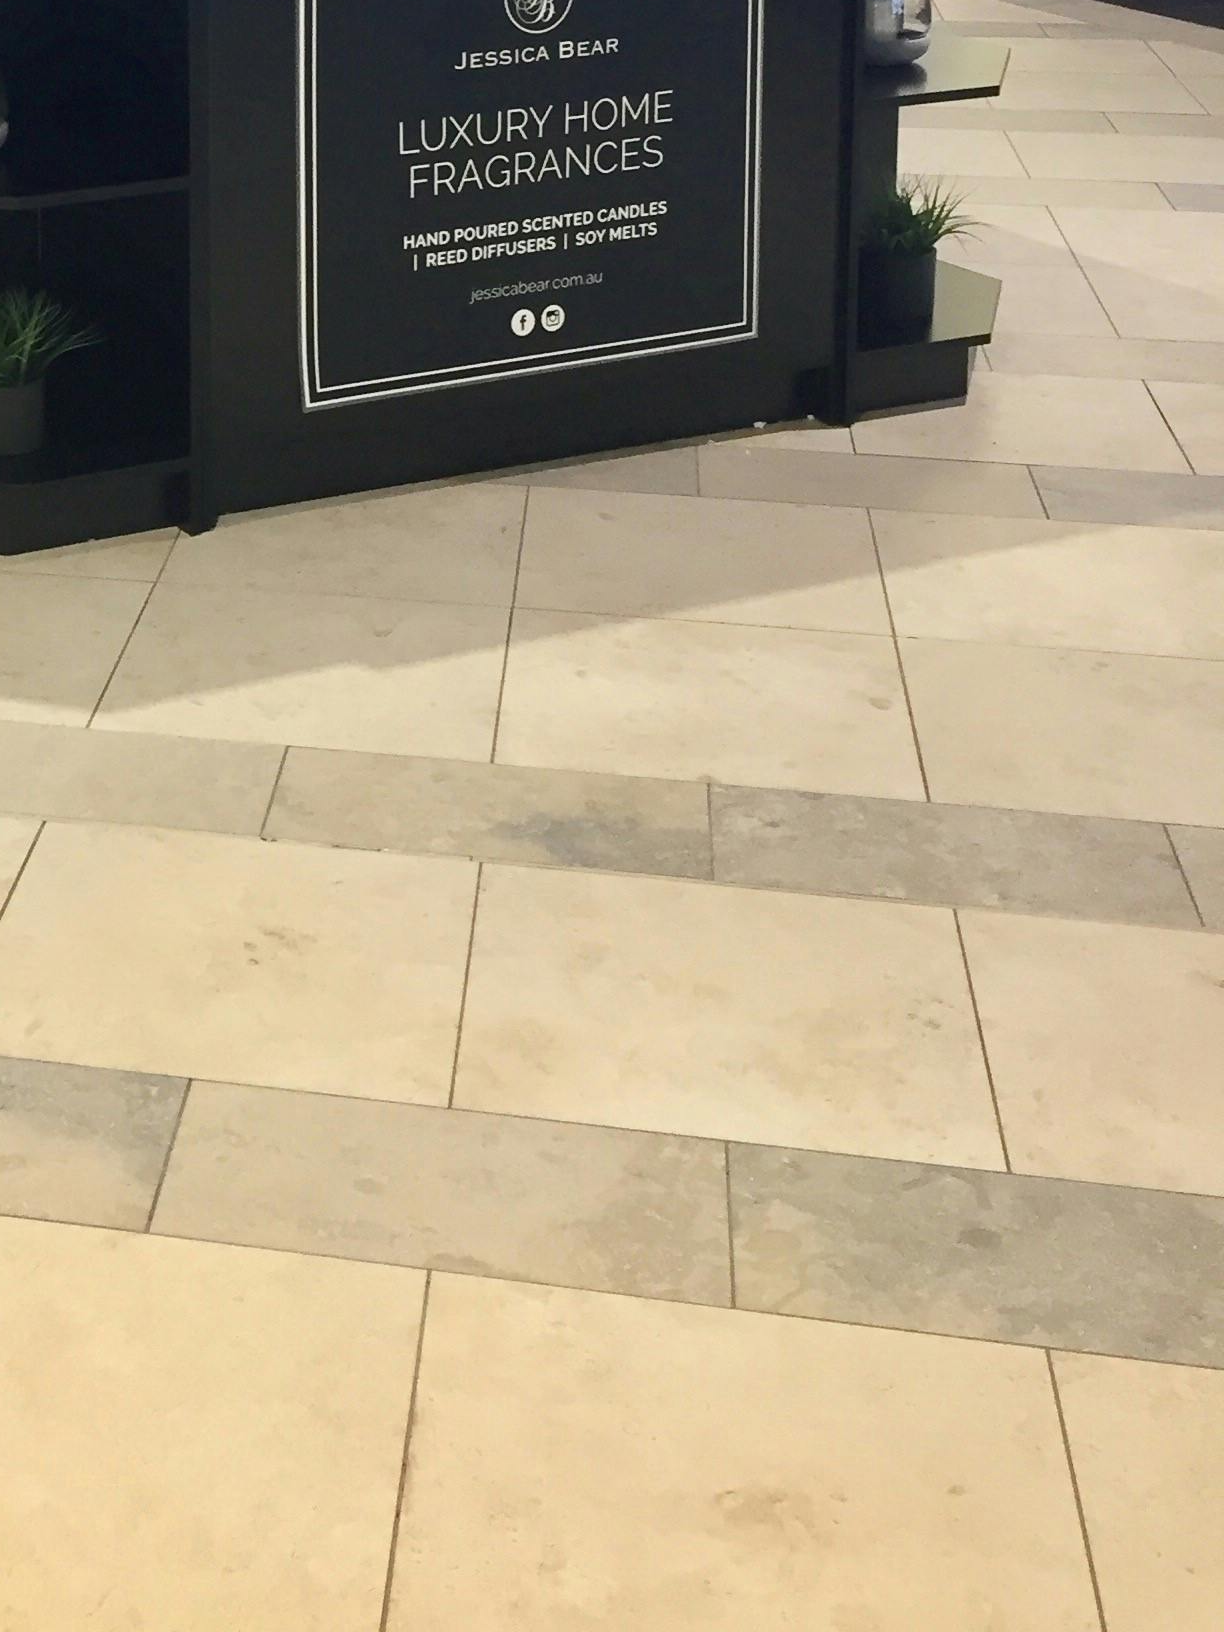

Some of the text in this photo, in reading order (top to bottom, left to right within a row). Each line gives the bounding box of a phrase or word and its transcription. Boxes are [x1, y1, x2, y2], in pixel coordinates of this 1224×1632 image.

[398, 89, 674, 155] LUXURY HOME
[409, 135, 664, 199] FRAGRANCES
[402, 200, 668, 250] HAND POURED SCENTED CANDLES
[425, 248, 469, 268] REED
[470, 235, 557, 261] DIFFUSERS
[575, 228, 607, 247] SOY
[608, 221, 659, 243] MELTS
[468, 271, 604, 305] jessicabear.com.au
